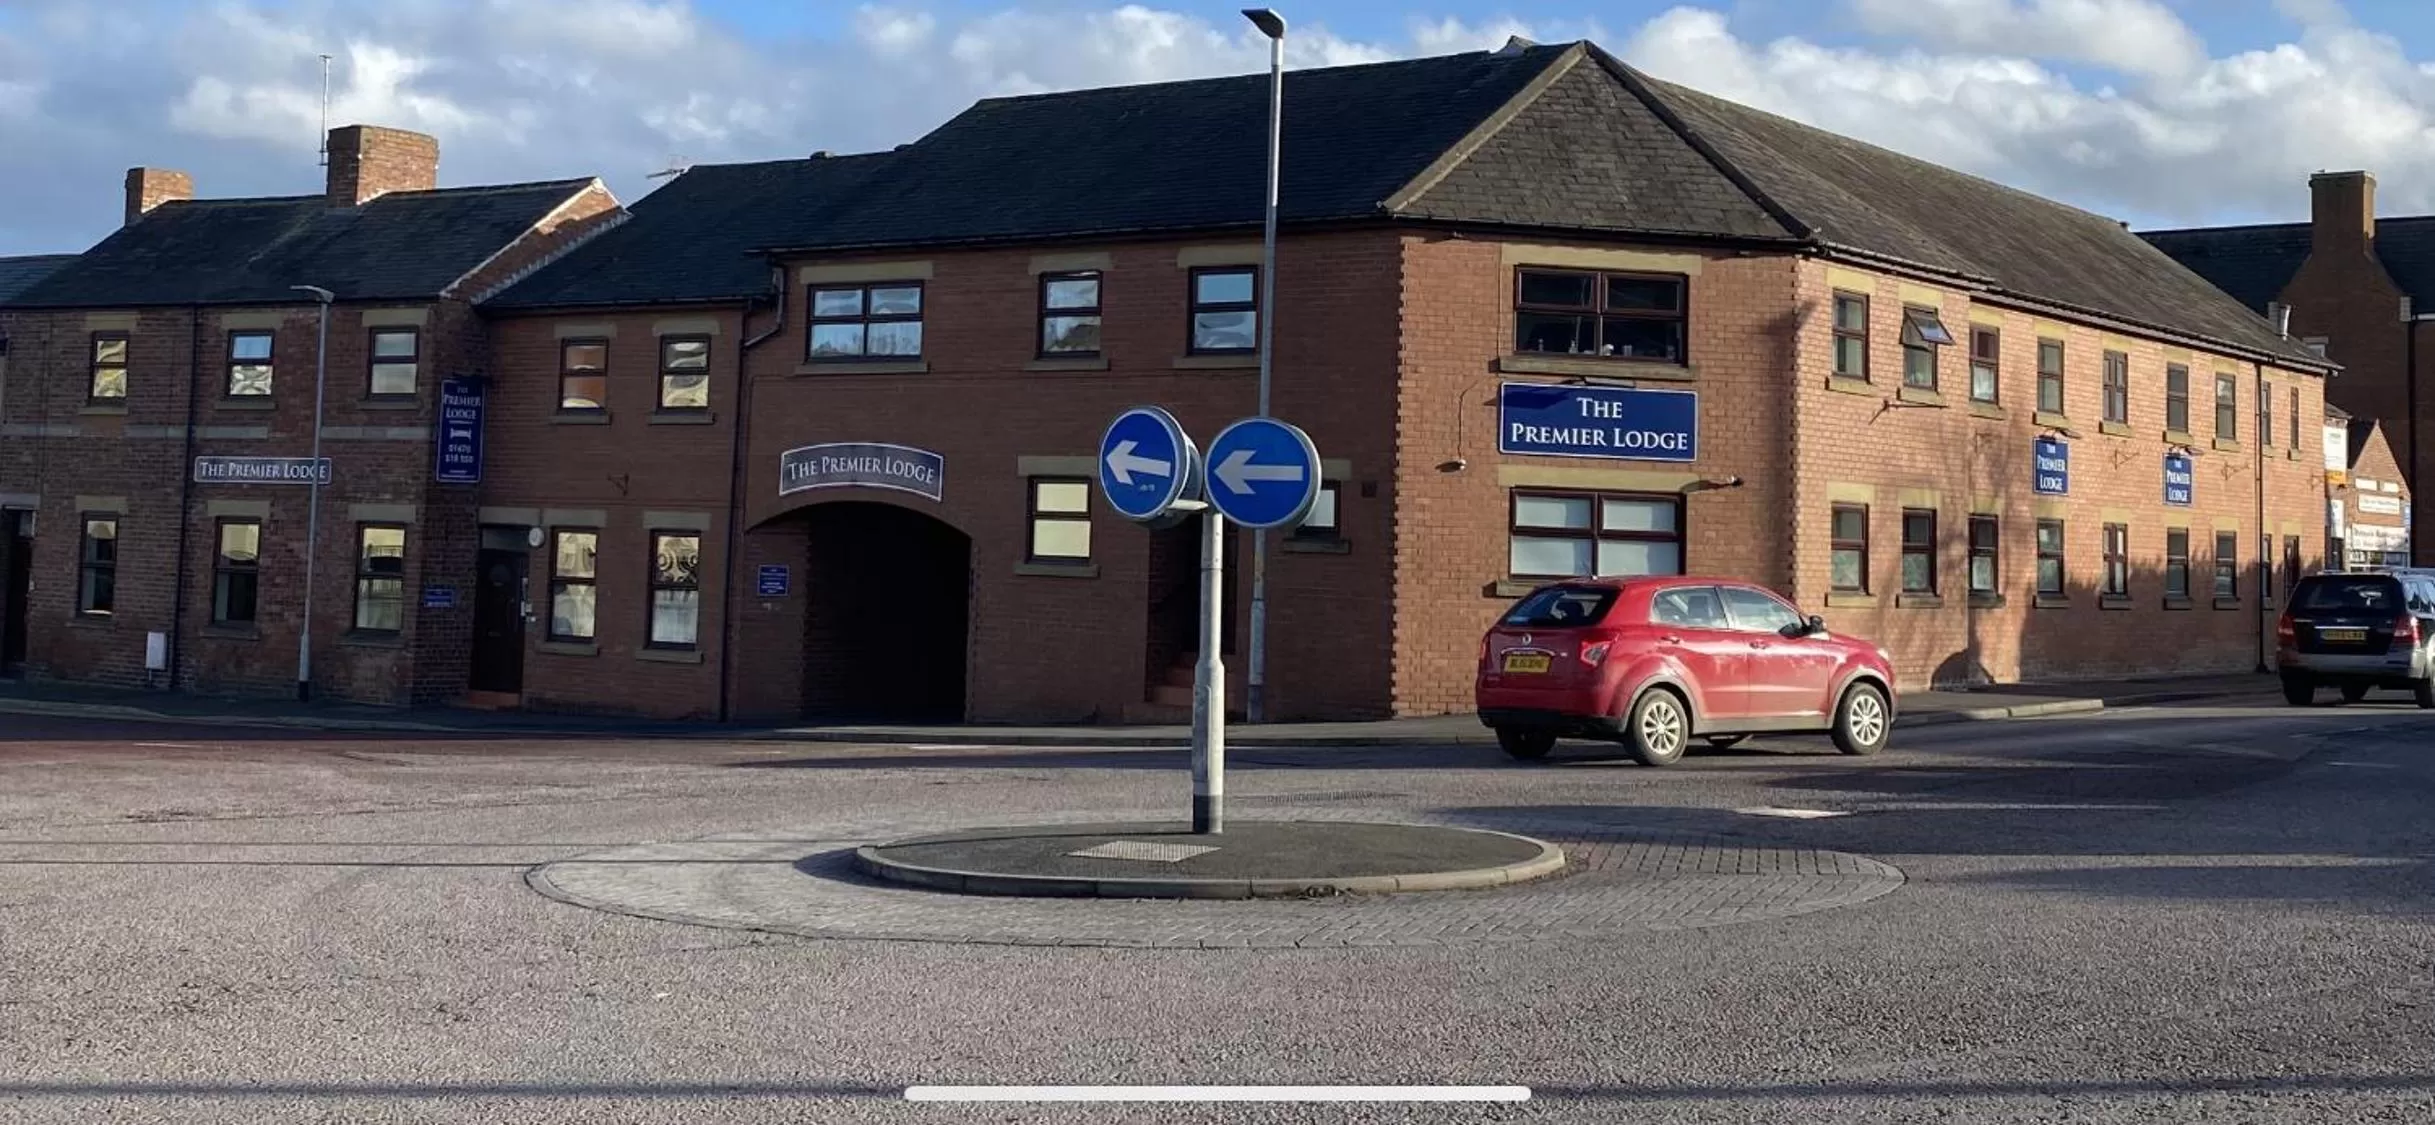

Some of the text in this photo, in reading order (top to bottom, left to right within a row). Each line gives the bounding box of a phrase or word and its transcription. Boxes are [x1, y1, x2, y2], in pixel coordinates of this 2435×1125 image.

[1577, 397, 1623, 419] THE
[1511, 423, 1688, 450] PREMIER LODGE
[201, 462, 225, 476] THE
[228, 462, 281, 478] PREMIER
[788, 456, 935, 484] THE PREMIER LODGE
[2037, 454, 2066, 472] PREMIER
[2040, 473, 2063, 491] LODGE
